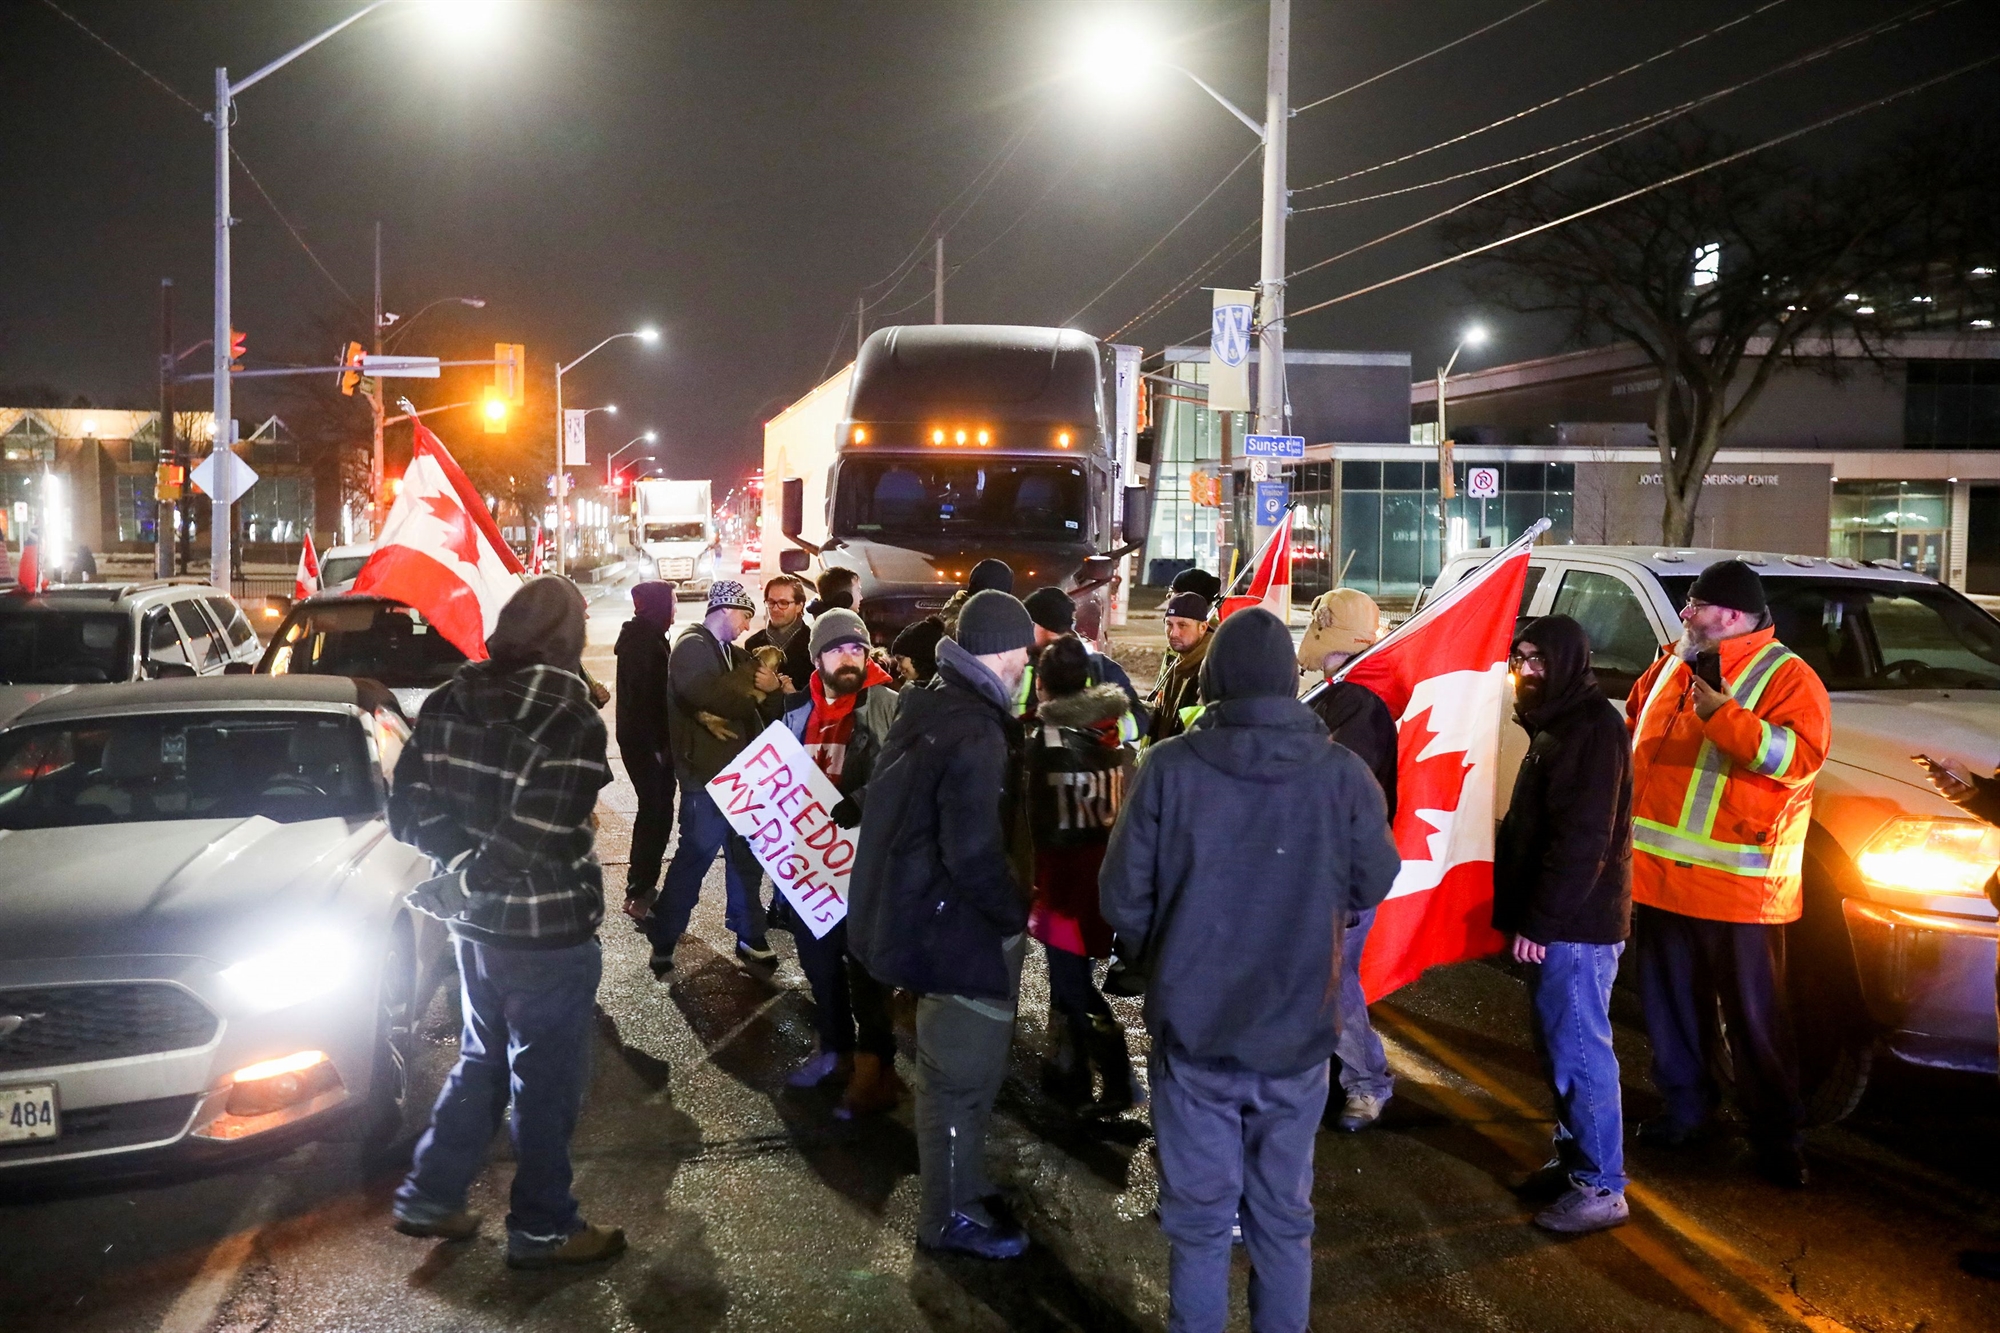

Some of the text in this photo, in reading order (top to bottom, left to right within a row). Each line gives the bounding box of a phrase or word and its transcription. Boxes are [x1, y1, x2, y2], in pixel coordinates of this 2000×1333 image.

[1248, 438, 1291, 452] Sunset
[1748, 474, 1779, 486] CENTRE
[744, 743, 854, 877] FREEDO
[10, 1100, 51, 1128] 484
